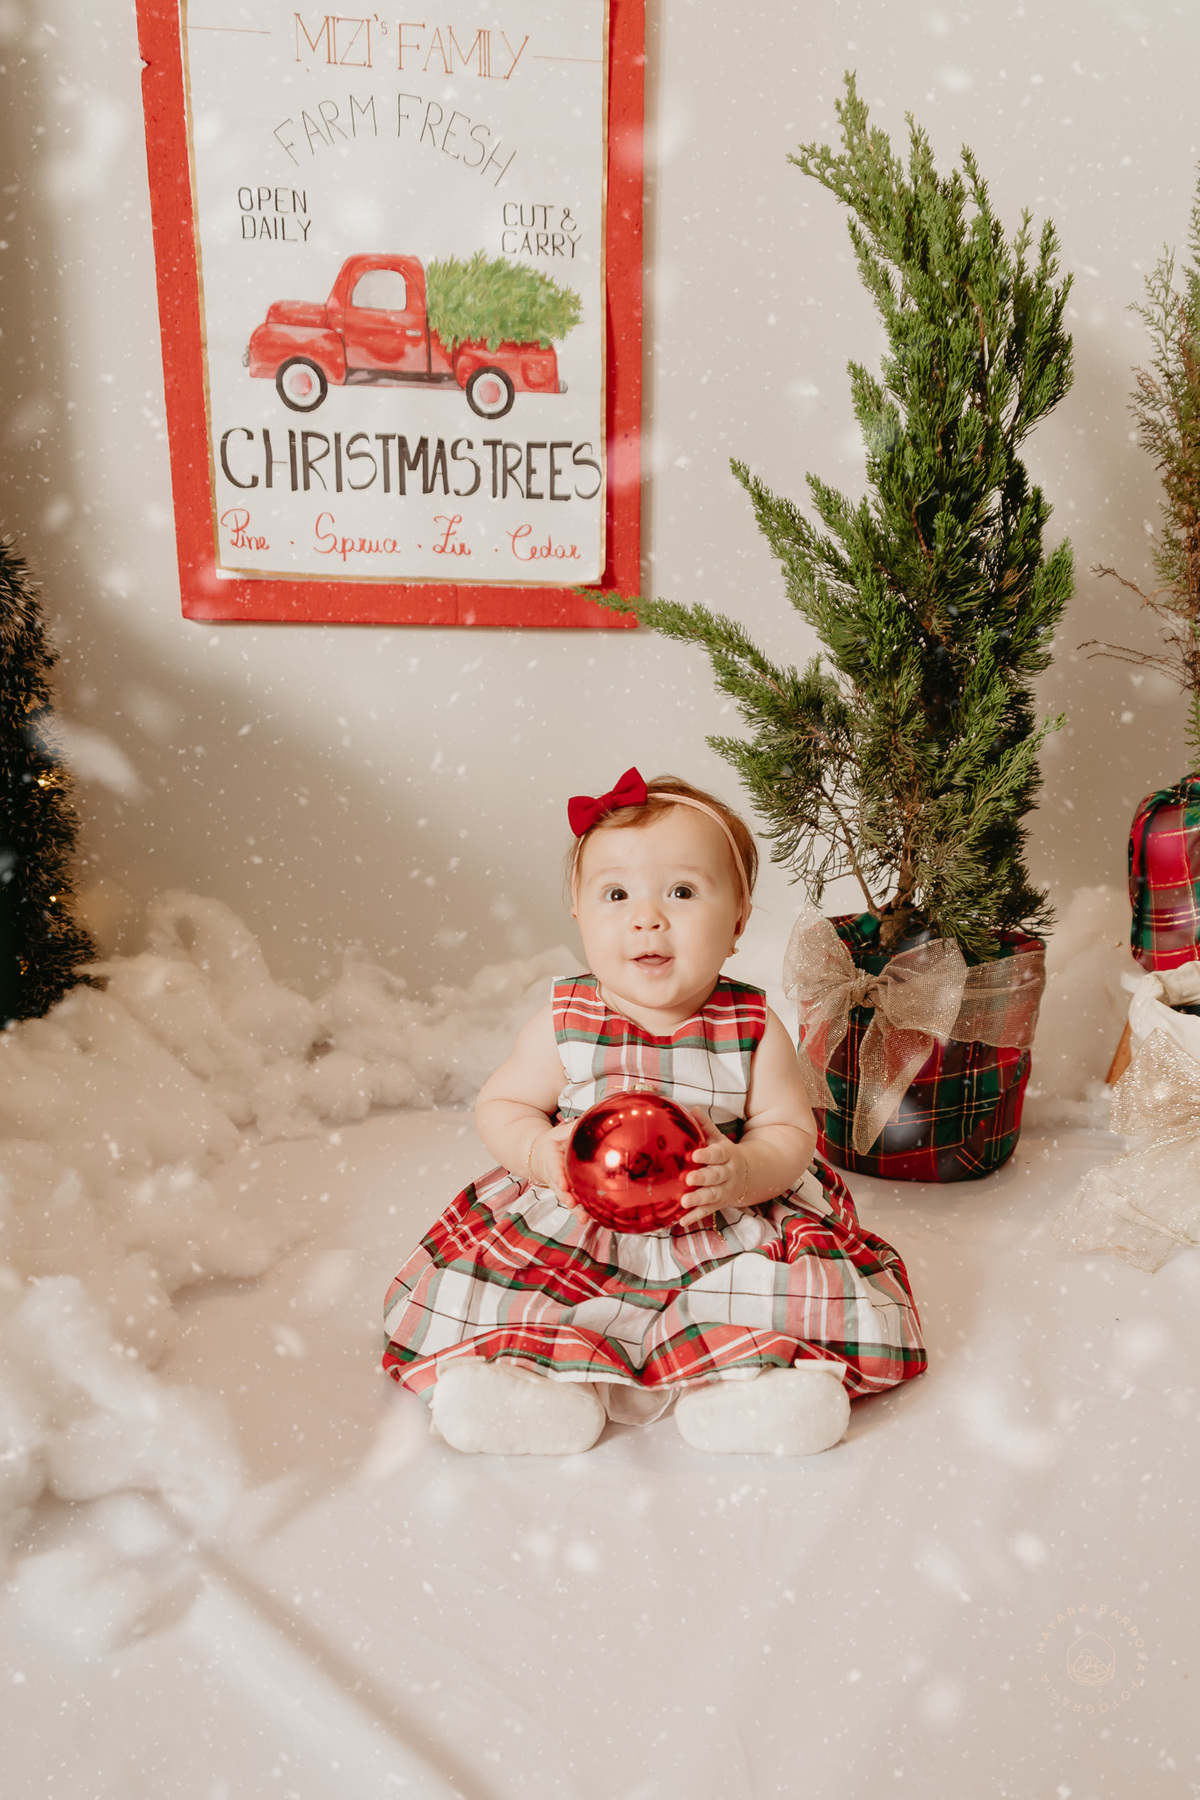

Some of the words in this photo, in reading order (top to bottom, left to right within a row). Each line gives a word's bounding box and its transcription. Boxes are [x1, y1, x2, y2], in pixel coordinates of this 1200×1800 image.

[397, 22, 530, 80] FAMILY
[272, 94, 379, 168] FARM
[397, 92, 517, 187] FRESH
[237, 187, 308, 215] OPEN
[502, 202, 555, 231] CUT
[560, 206, 578, 232] &
[240, 214, 312, 242] DAILY
[501, 231, 582, 258] CARRY
[220, 427, 482, 497] CHRISTMAS
[483, 438, 602, 501] TREES
[220, 508, 270, 551] Pine
[506, 523, 581, 561] Cedar
